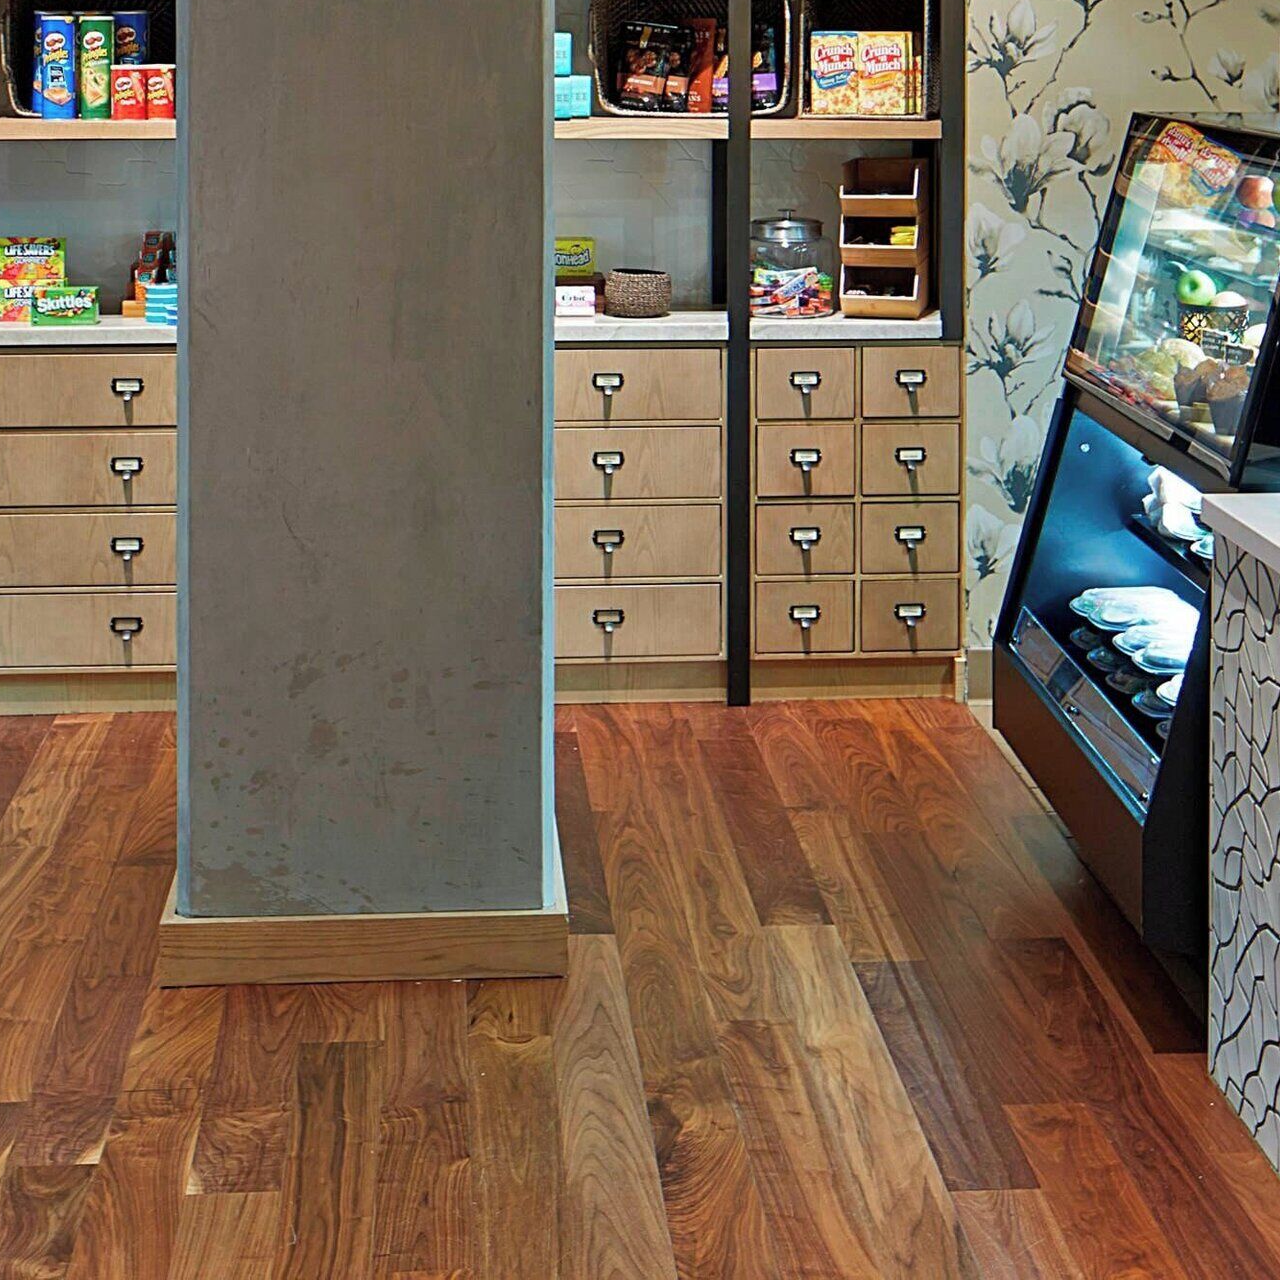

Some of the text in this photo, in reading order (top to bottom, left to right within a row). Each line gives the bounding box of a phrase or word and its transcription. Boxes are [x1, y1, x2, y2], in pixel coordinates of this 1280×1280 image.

[815, 43, 855, 62] Crunch
[862, 43, 902, 62] Crunch
[817, 60, 855, 74] Munch
[864, 60, 902, 75] Munch
[23, 244, 55, 257] SAVERS
[36, 294, 93, 313] Skittles
